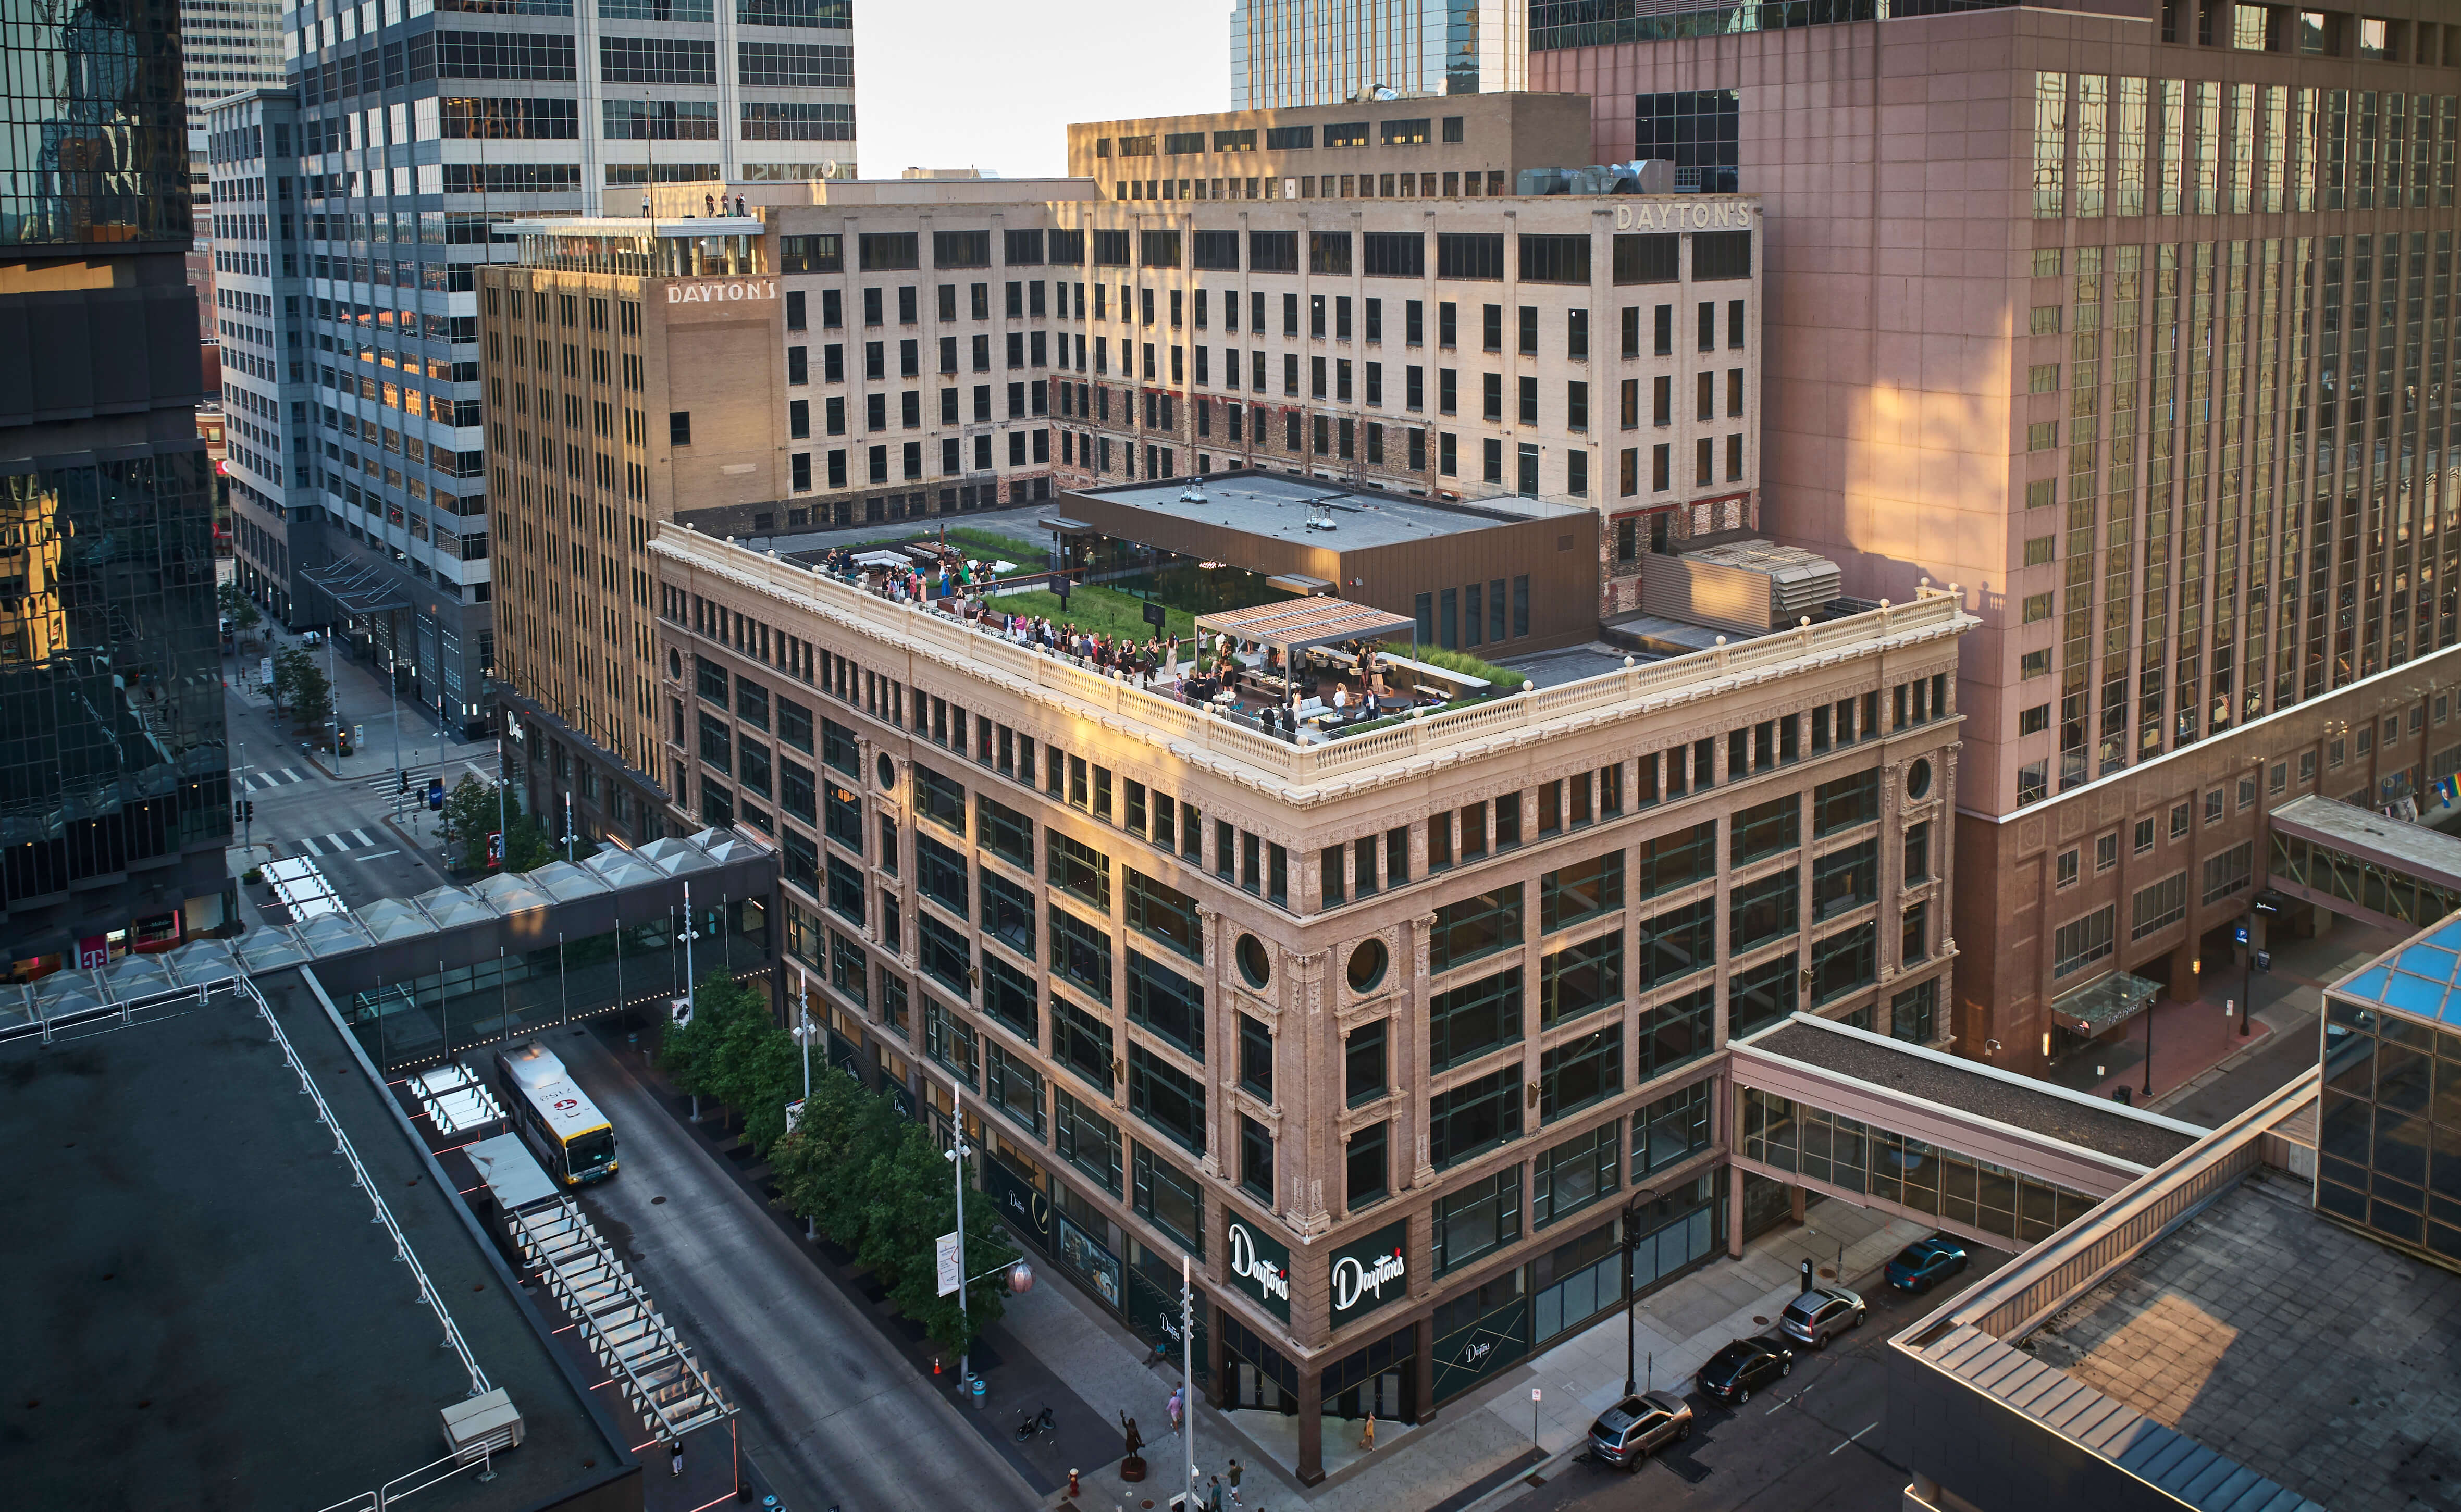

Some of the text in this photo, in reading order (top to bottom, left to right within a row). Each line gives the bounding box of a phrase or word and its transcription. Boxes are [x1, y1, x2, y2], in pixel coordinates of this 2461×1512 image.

[1617, 202, 1749, 230] DAYTON'S
[667, 280, 775, 303] DAYTON'S
[1229, 1223, 1289, 1301] Dayton's
[1332, 1247, 1405, 1311] Dayton's
